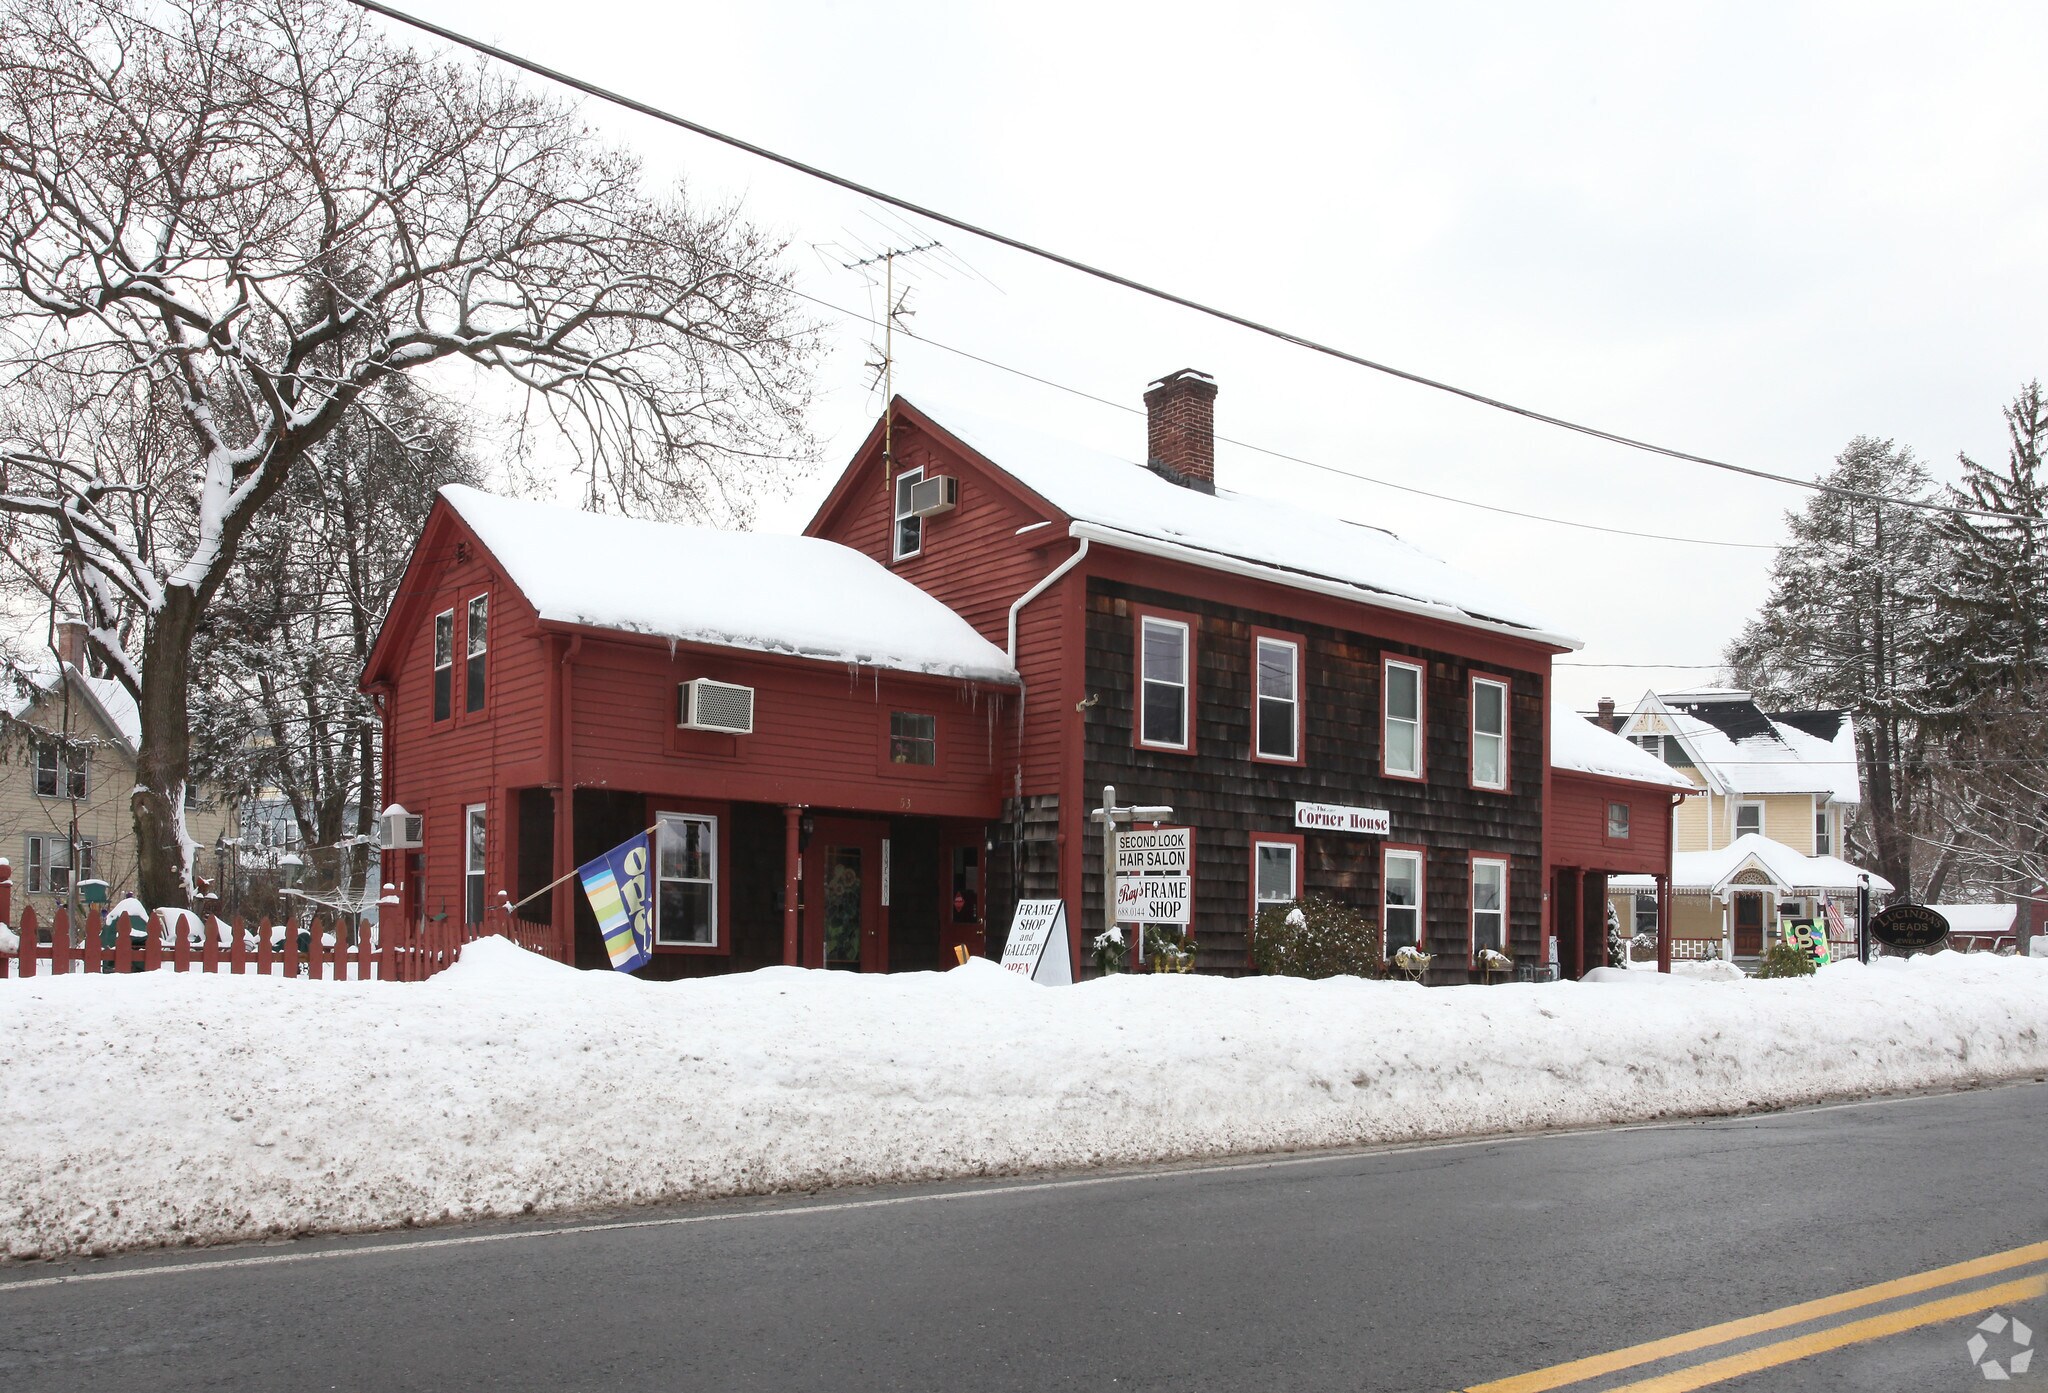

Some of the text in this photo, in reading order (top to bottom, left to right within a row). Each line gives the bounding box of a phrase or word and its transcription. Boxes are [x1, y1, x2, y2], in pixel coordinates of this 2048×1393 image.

[1298, 809, 1387, 830] Corner House
[1120, 834, 1184, 848] SECOND LOOK
[1119, 851, 1185, 866] HAIR SALON
[1144, 882, 1187, 898] FRAME
[1018, 904, 1056, 916] FRAME
[1149, 901, 1181, 918] SHOP
[1019, 918, 1046, 931] SHOP
[1877, 909, 1943, 928] LUCINDA'S
[1892, 922, 1929, 931] BEADS
[1019, 932, 1034, 942] and
[1004, 943, 1042, 957] GALLERY
